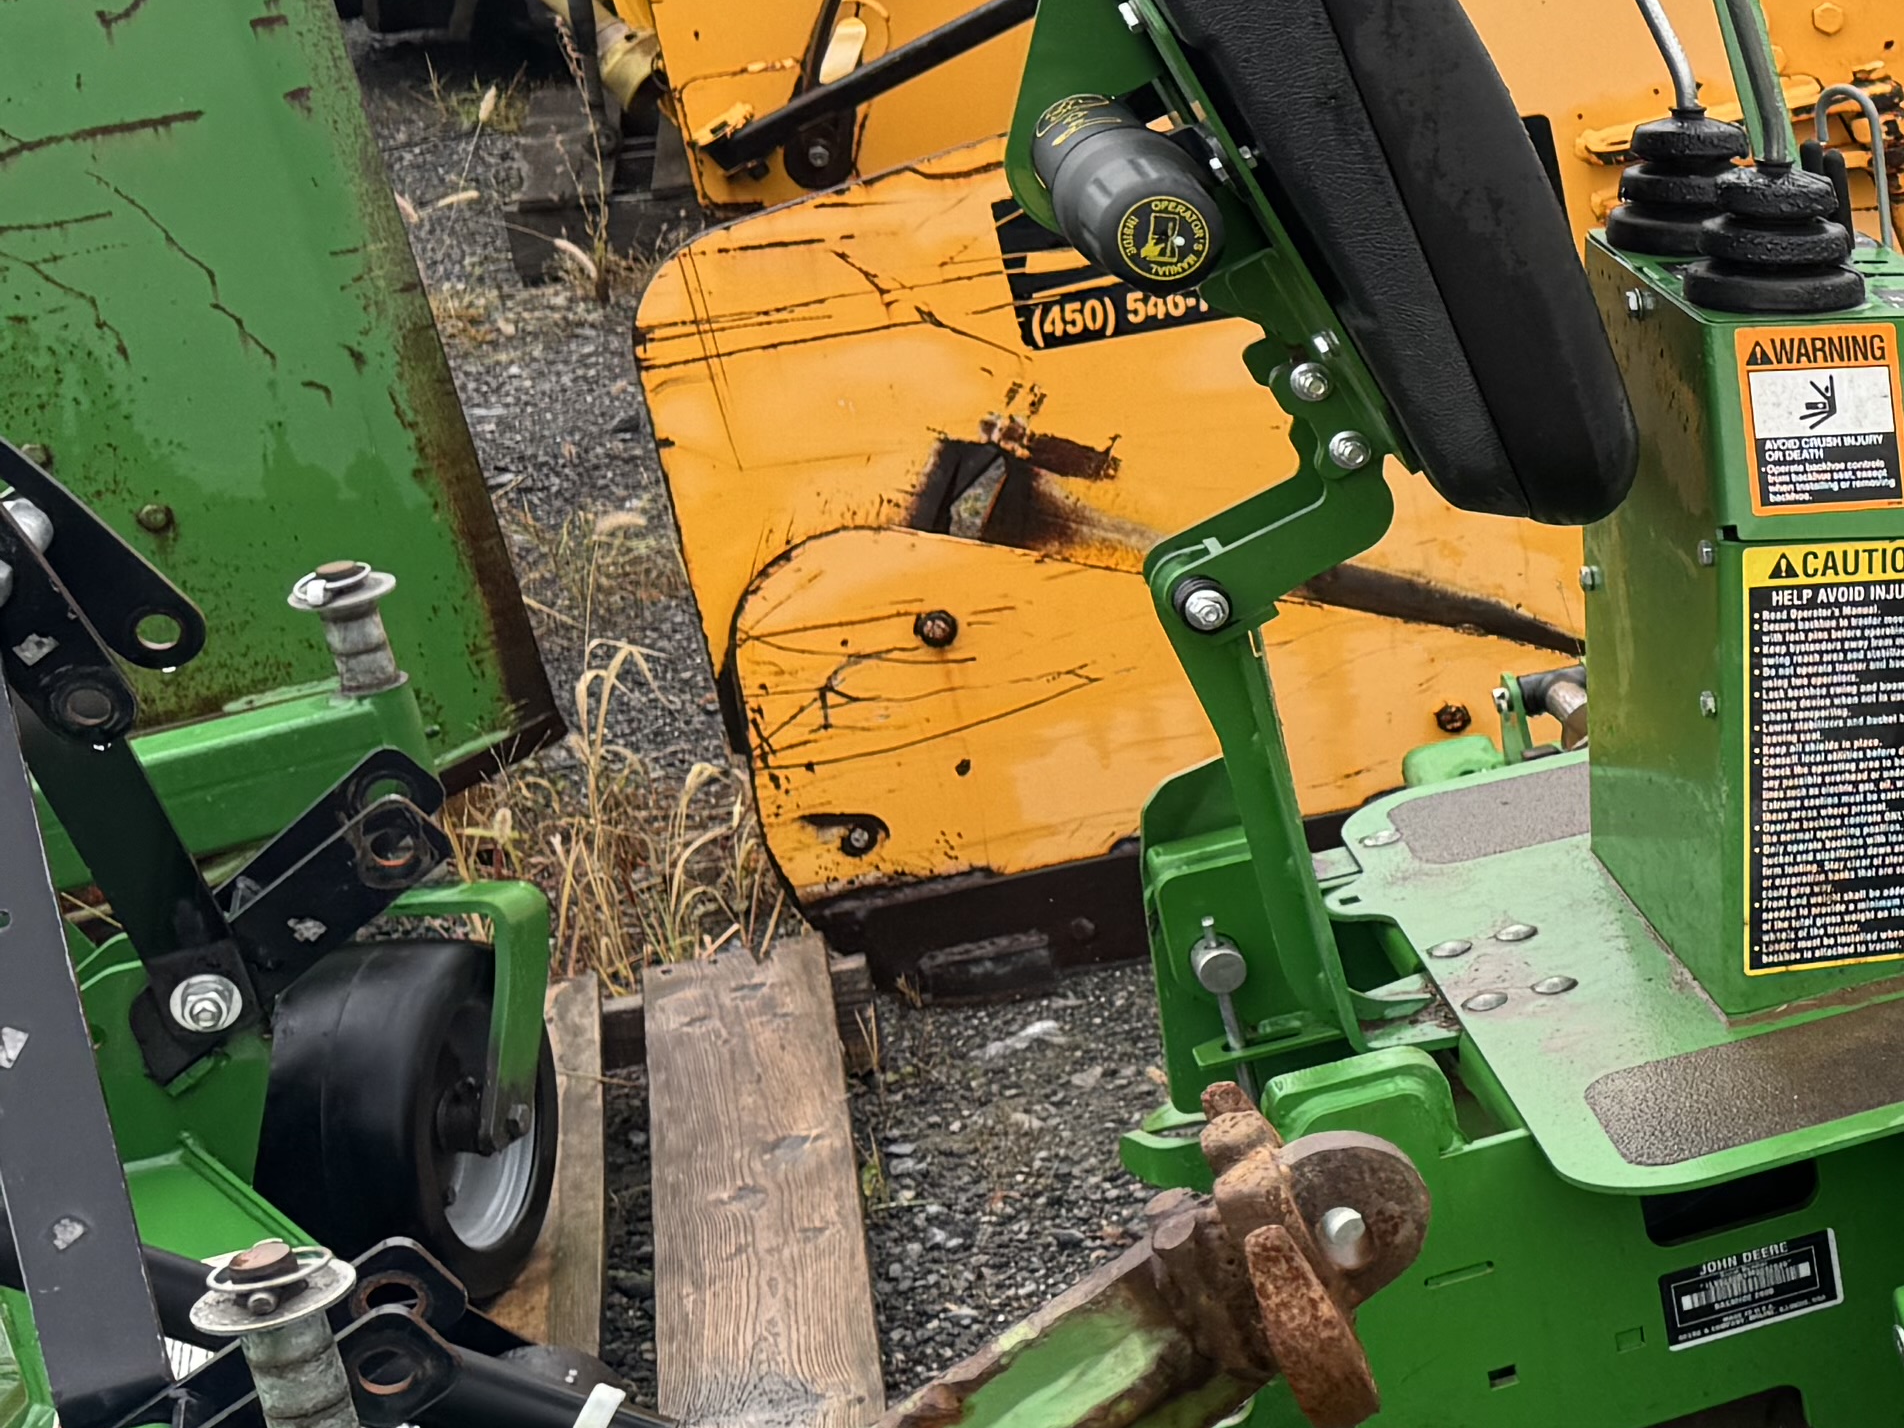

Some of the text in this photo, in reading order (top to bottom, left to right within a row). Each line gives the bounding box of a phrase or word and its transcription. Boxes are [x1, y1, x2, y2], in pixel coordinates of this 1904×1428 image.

[1151, 201, 1205, 252] OPERATOR'S
[1150, 253, 1198, 276] MANUAL
[1032, 296, 1116, 349] (450)
[1771, 334, 1886, 365] WARNING
[1764, 433, 1883, 450] AVOID CRUSH INJURY
[1765, 448, 1823, 461] OR DEATH
[1771, 588, 1812, 606] HELP
[1816, 585, 1864, 604] AVOID
[1699, 1255, 1738, 1276] JOHN
[1743, 1241, 1788, 1263] DEERE
